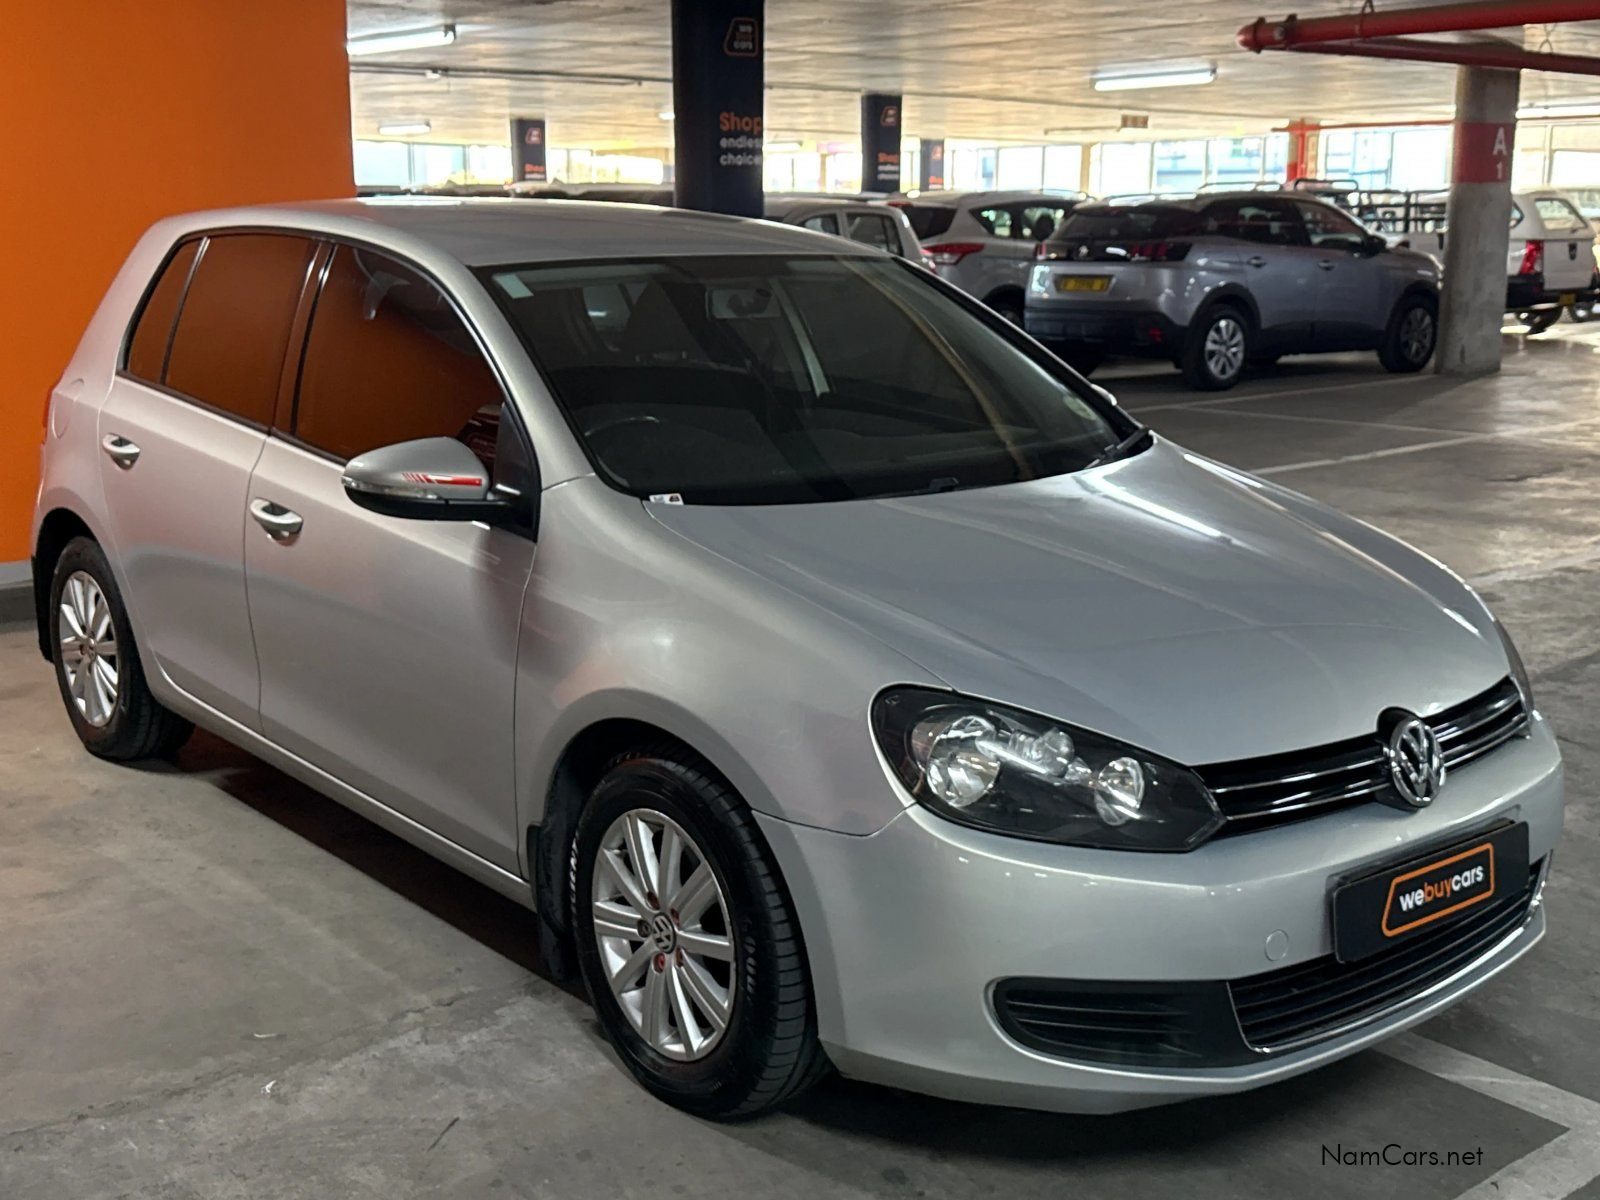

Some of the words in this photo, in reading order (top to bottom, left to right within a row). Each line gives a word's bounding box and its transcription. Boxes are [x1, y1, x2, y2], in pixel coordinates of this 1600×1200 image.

[720, 112, 762, 134] Shop
[1493, 127, 1507, 155] A
[1497, 162, 1502, 179] 1
[1399, 866, 1484, 912] webuycars
